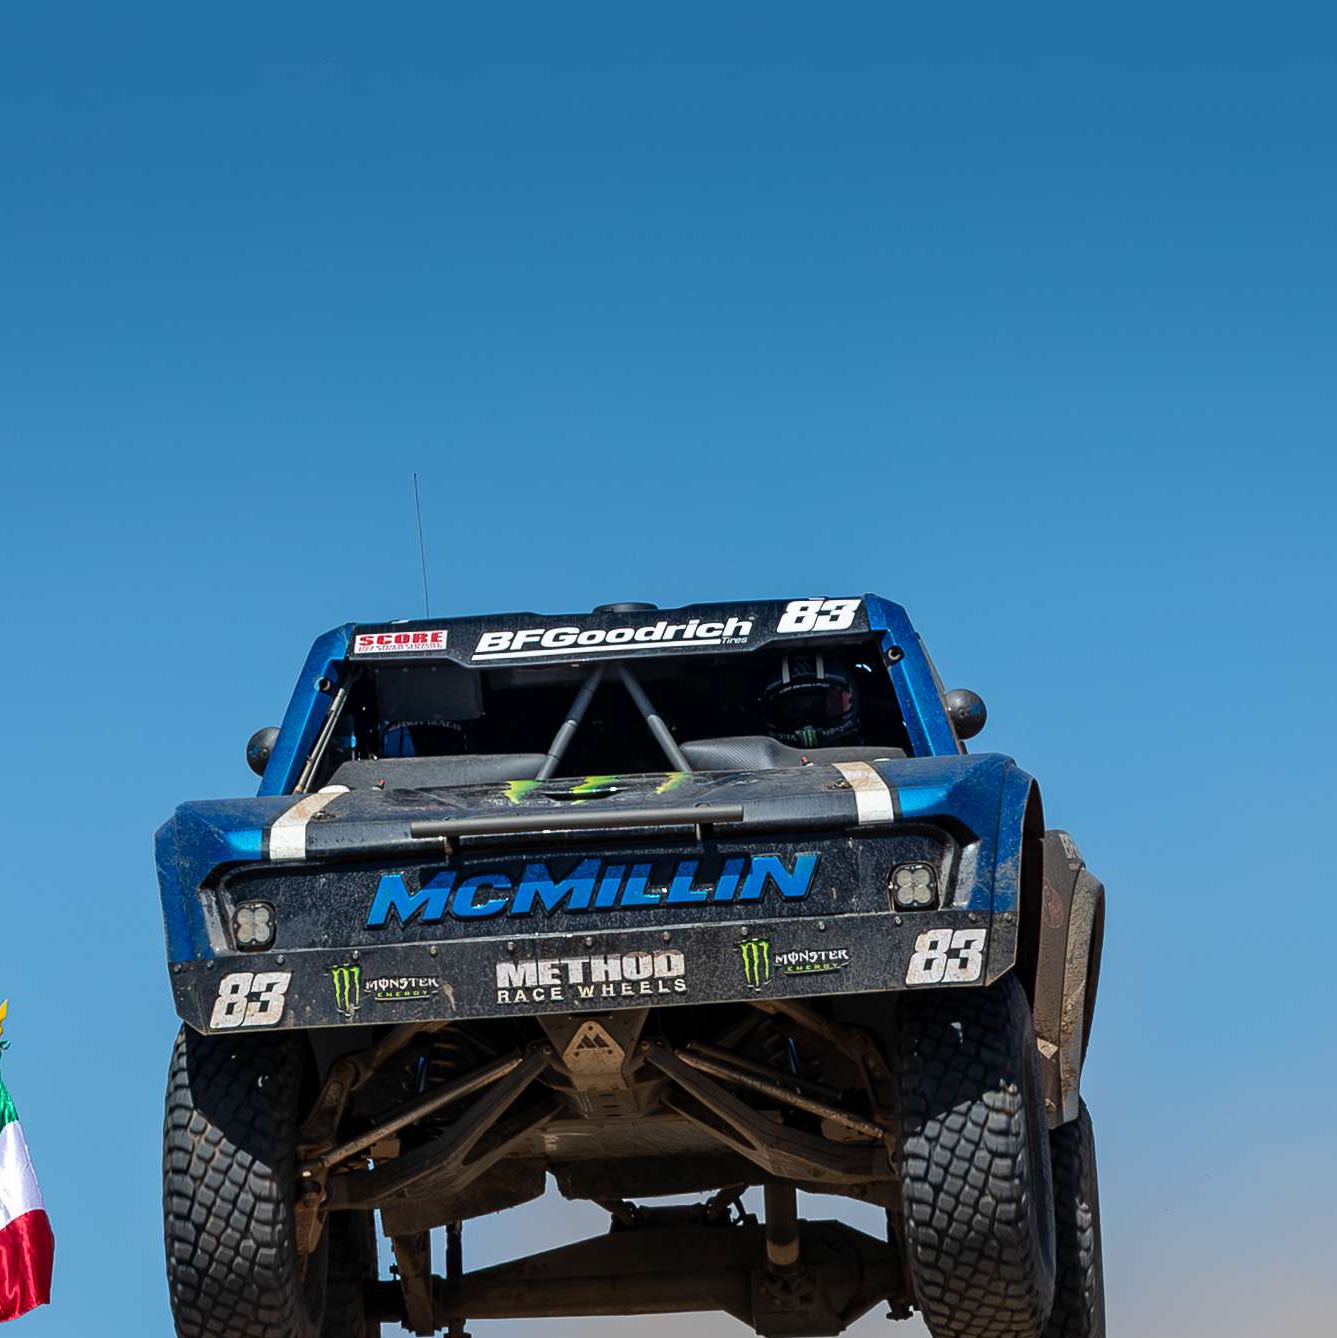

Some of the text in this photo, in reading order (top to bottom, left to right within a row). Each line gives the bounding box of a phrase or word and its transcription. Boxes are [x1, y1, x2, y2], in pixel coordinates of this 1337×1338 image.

[776, 599, 862, 634] 83
[359, 632, 443, 646] SCORE
[475, 617, 753, 652] BFGoodrich
[722, 636, 748, 645] Tires
[775, 949, 849, 965] MONSTER
[787, 962, 839, 972] ENERGY
[906, 929, 987, 985] 83
[496, 950, 686, 988] METHOD
[365, 977, 440, 991] MONSTER
[376, 990, 430, 998] ENERGY
[497, 979, 687, 1004] RACE WHEELS
[209, 971, 293, 1028] 83
